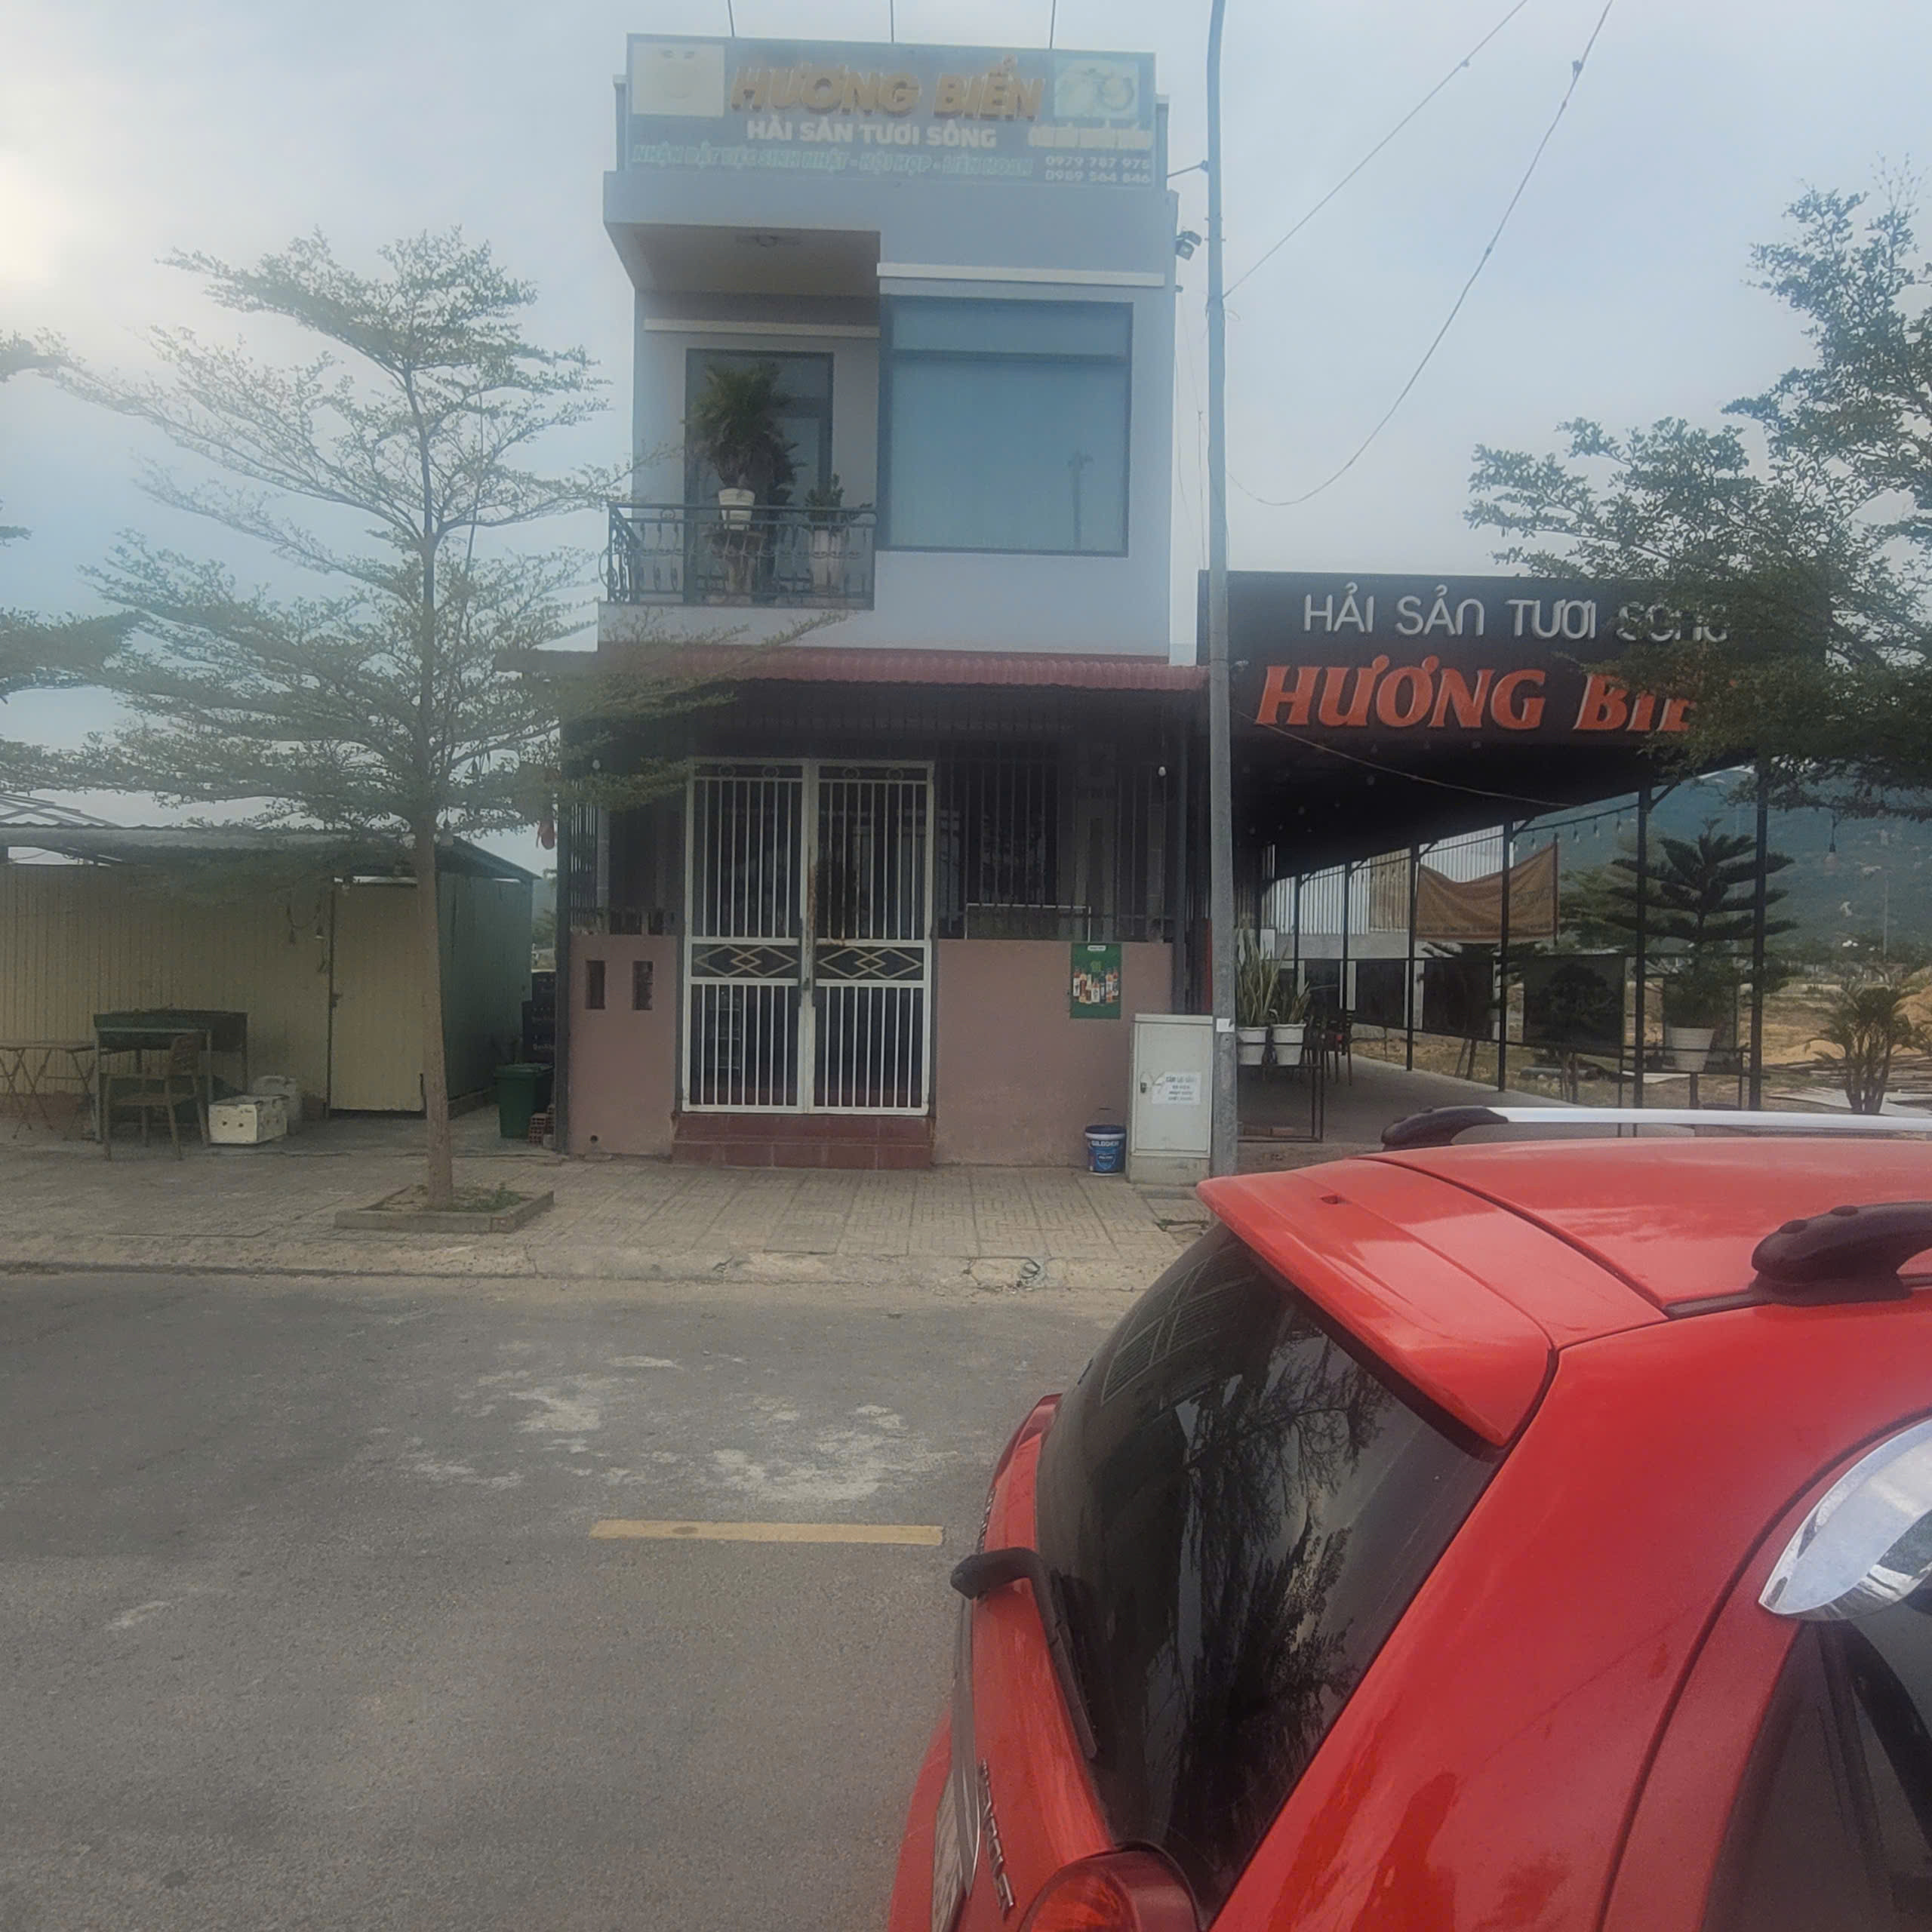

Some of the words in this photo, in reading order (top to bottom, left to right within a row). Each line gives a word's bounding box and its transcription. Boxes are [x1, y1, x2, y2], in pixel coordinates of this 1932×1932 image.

[731, 63, 922, 118] HƯƠNG
[860, 121, 921, 146] TƯƠI
[1303, 583, 1374, 633] HẢI
[1507, 598, 1597, 640] TƯƠI
[1255, 654, 1546, 730] HƯƠNG
